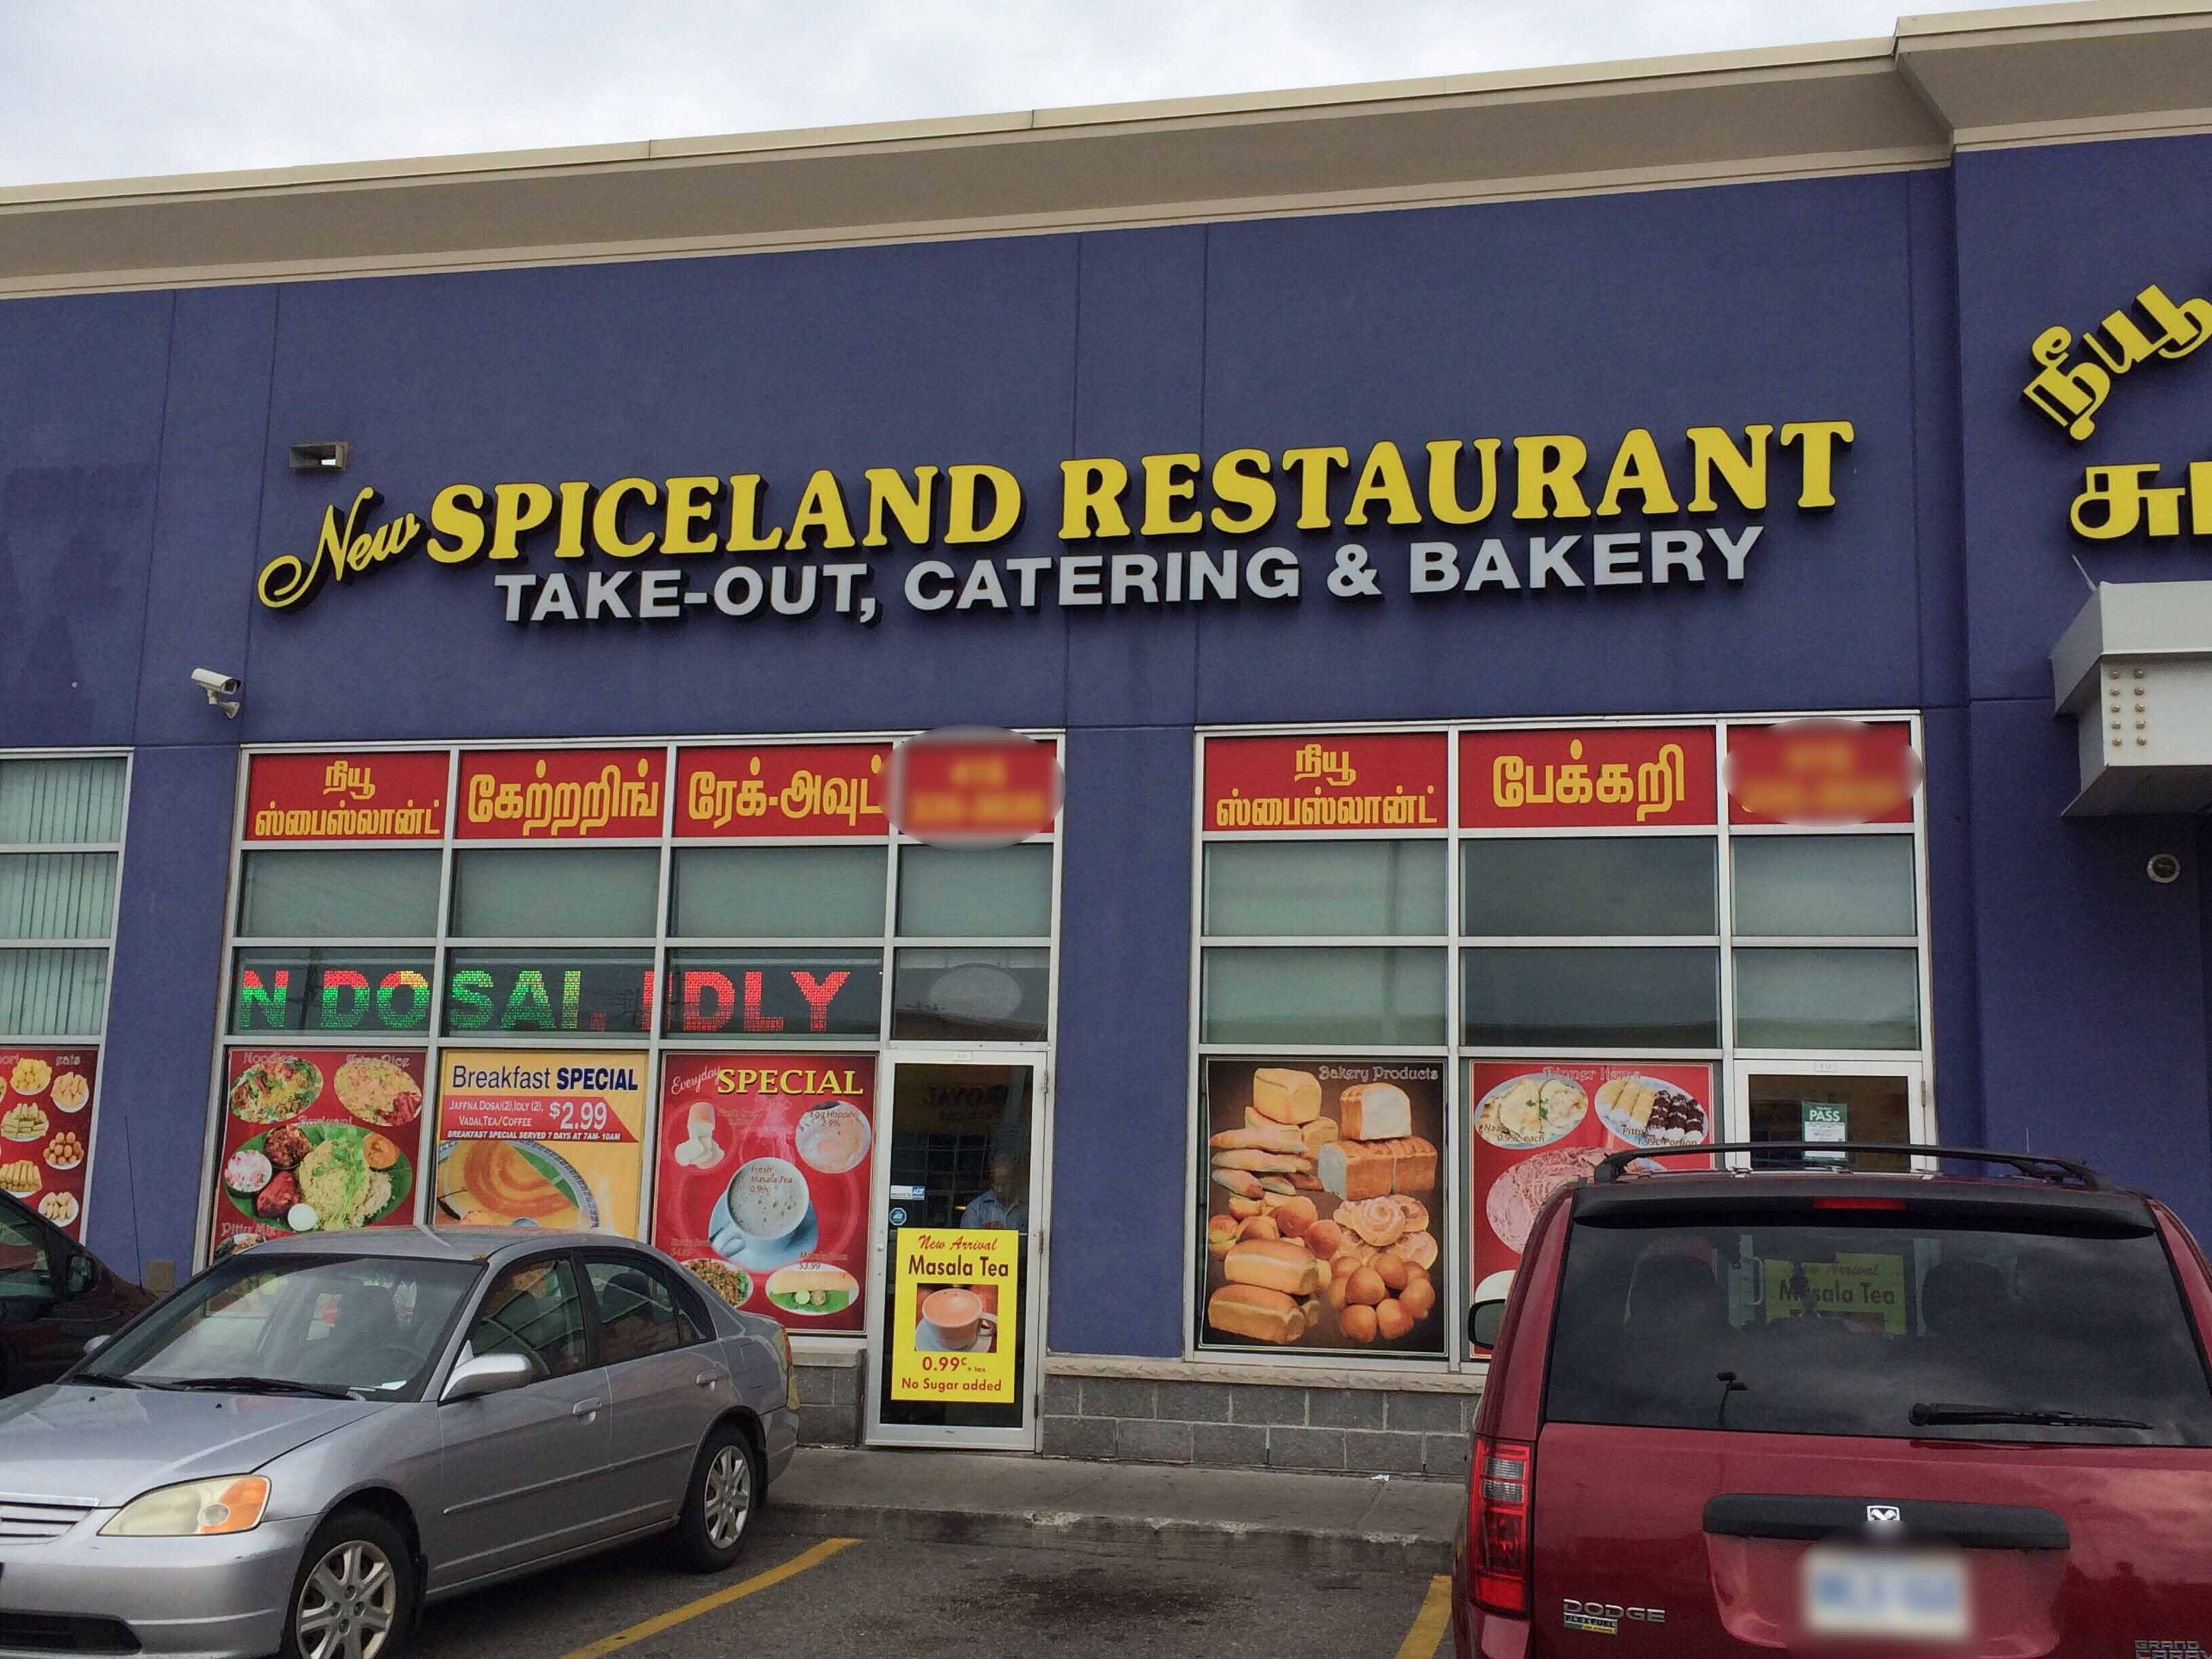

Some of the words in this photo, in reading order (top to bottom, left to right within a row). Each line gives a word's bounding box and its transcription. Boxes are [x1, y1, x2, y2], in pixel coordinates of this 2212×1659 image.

[257, 486, 419, 609] New
[426, 464, 1022, 563] SPICELAND
[1058, 420, 1854, 539] RESTAURANT
[494, 563, 875, 623] TAKE-OUT,
[904, 547, 1299, 612] CATERING
[1326, 544, 1382, 598] &
[1410, 526, 1764, 594] BAKERY
[1492, 738, 1685, 822] பேக்கறி
[640, 970, 851, 1031] IDLY
[452, 1065, 551, 1089] Breakfast
[556, 1067, 638, 1090] SPECIAL
[671, 1065, 722, 1095] Everyday
[717, 1069, 863, 1095] SPECIAL
[1318, 1065, 1370, 1083] Bakery
[1372, 1065, 1439, 1082] Products
[549, 1101, 608, 1130] $2.99
[1809, 1109, 1840, 1122] PASS
[447, 1130, 487, 1139] BREAKFAST
[519, 1131, 546, 1139] SERVED
[918, 1234, 945, 1250] New
[949, 1235, 998, 1250] Arrival
[908, 1254, 972, 1276] Masala
[979, 1256, 1009, 1277] Tea
[1860, 1282, 1896, 1305] Tea
[901, 1377, 919, 1389] No
[923, 1378, 958, 1393] Sugar
[962, 1378, 1002, 1391] added
[1563, 1599, 1666, 1623] DODGE
[2135, 1640, 2200, 1650] GRAND
